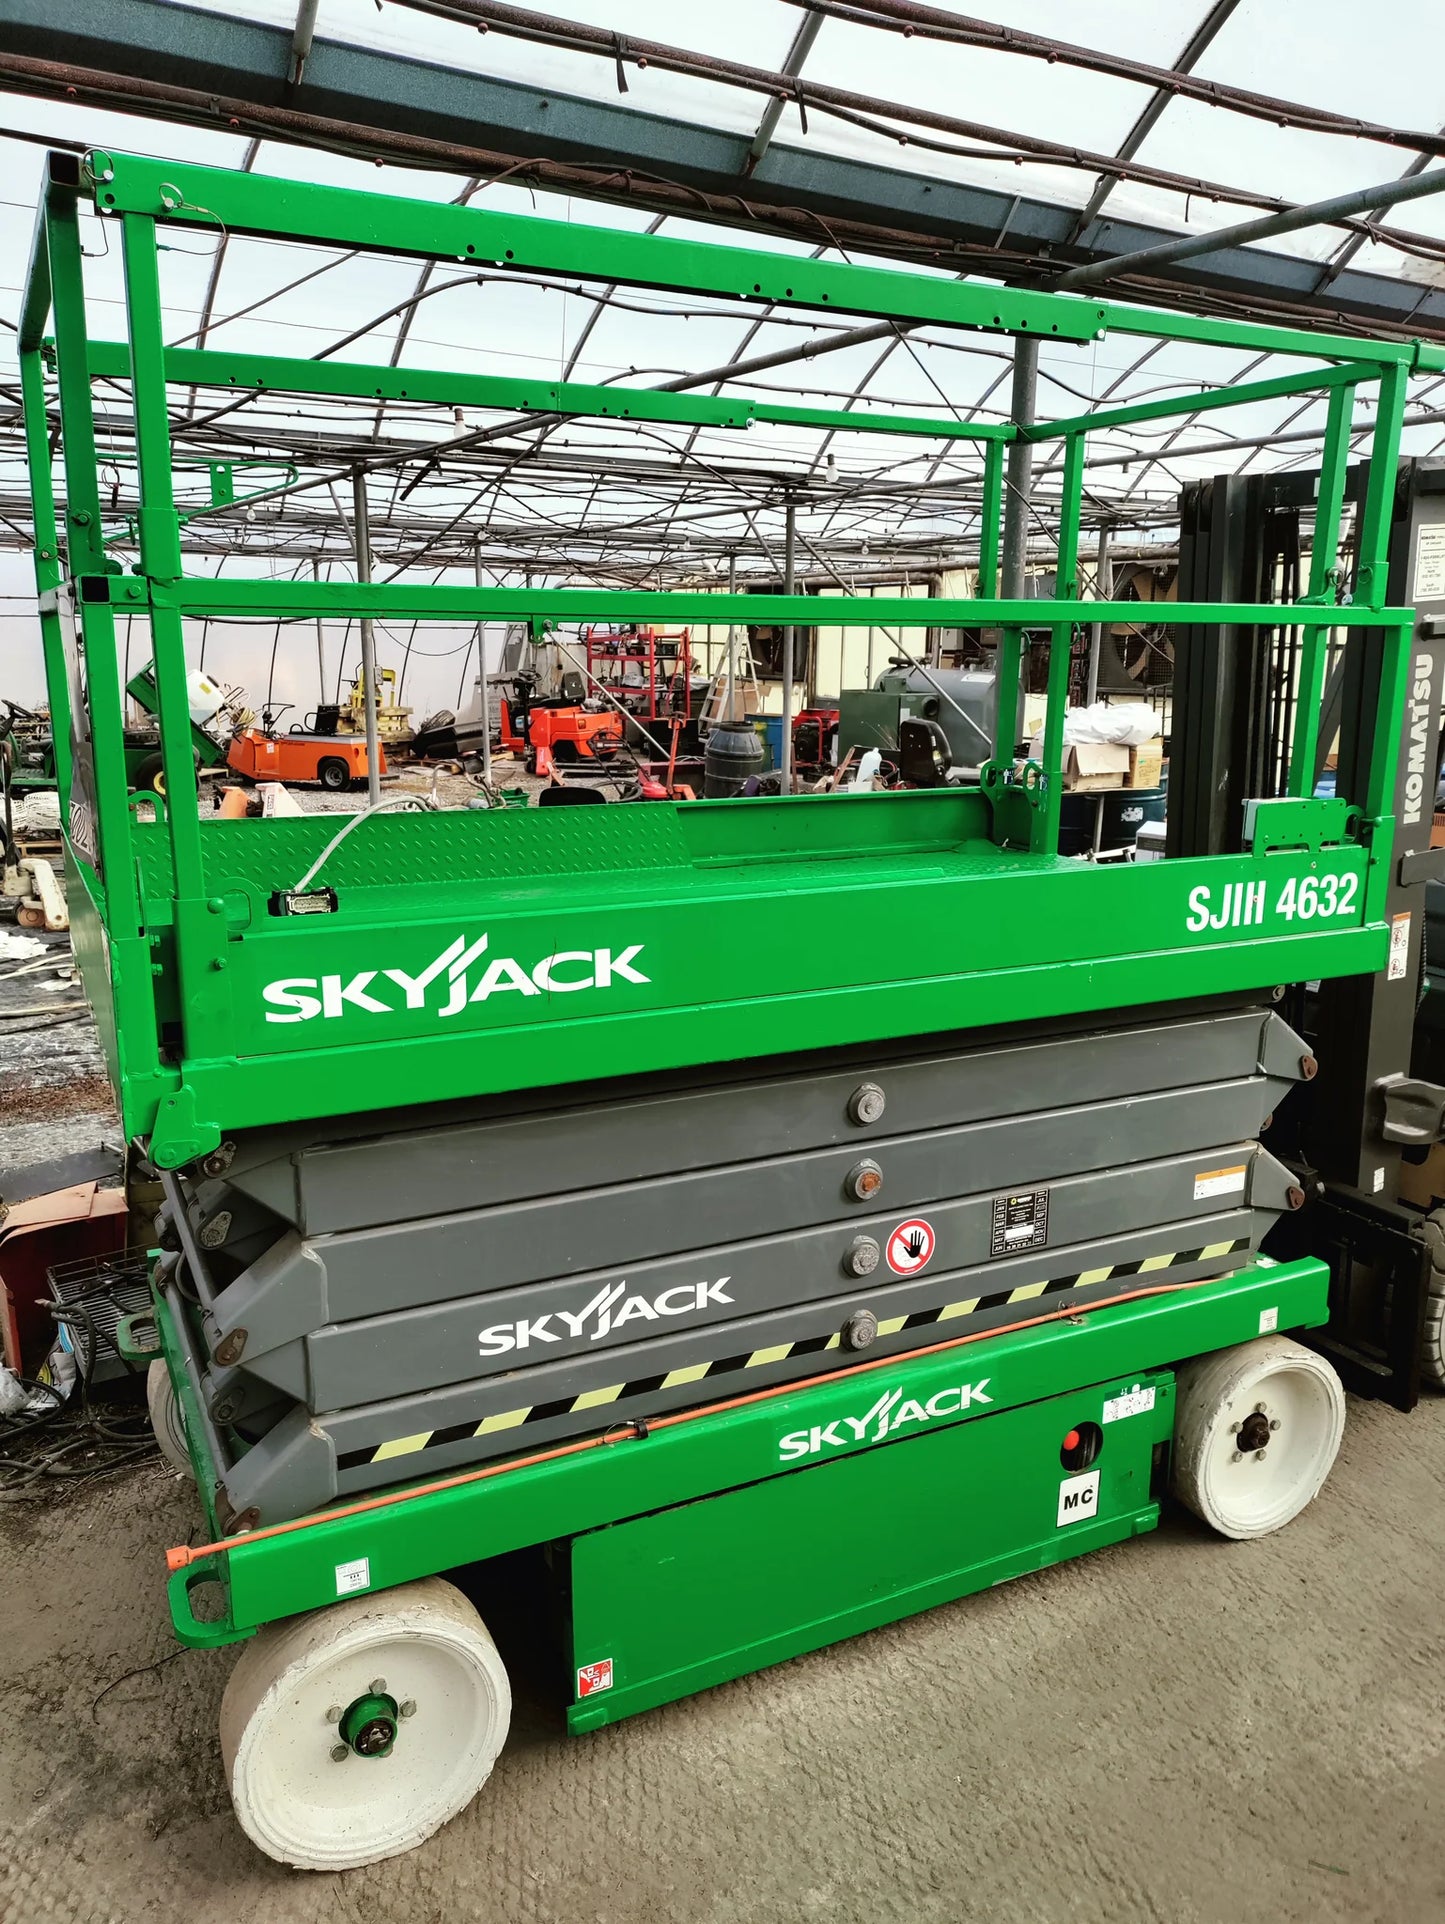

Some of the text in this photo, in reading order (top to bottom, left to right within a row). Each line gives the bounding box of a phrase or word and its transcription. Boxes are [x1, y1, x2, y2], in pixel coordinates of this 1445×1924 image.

[1403, 653, 1433, 824] KOMATSU
[1275, 872, 1358, 921] 4632
[261, 931, 652, 1024] SKYJACK
[478, 1276, 736, 1356] SKYJACK
[778, 1378, 994, 1460] SKYJACK
[1063, 1488, 1093, 1511] MC
